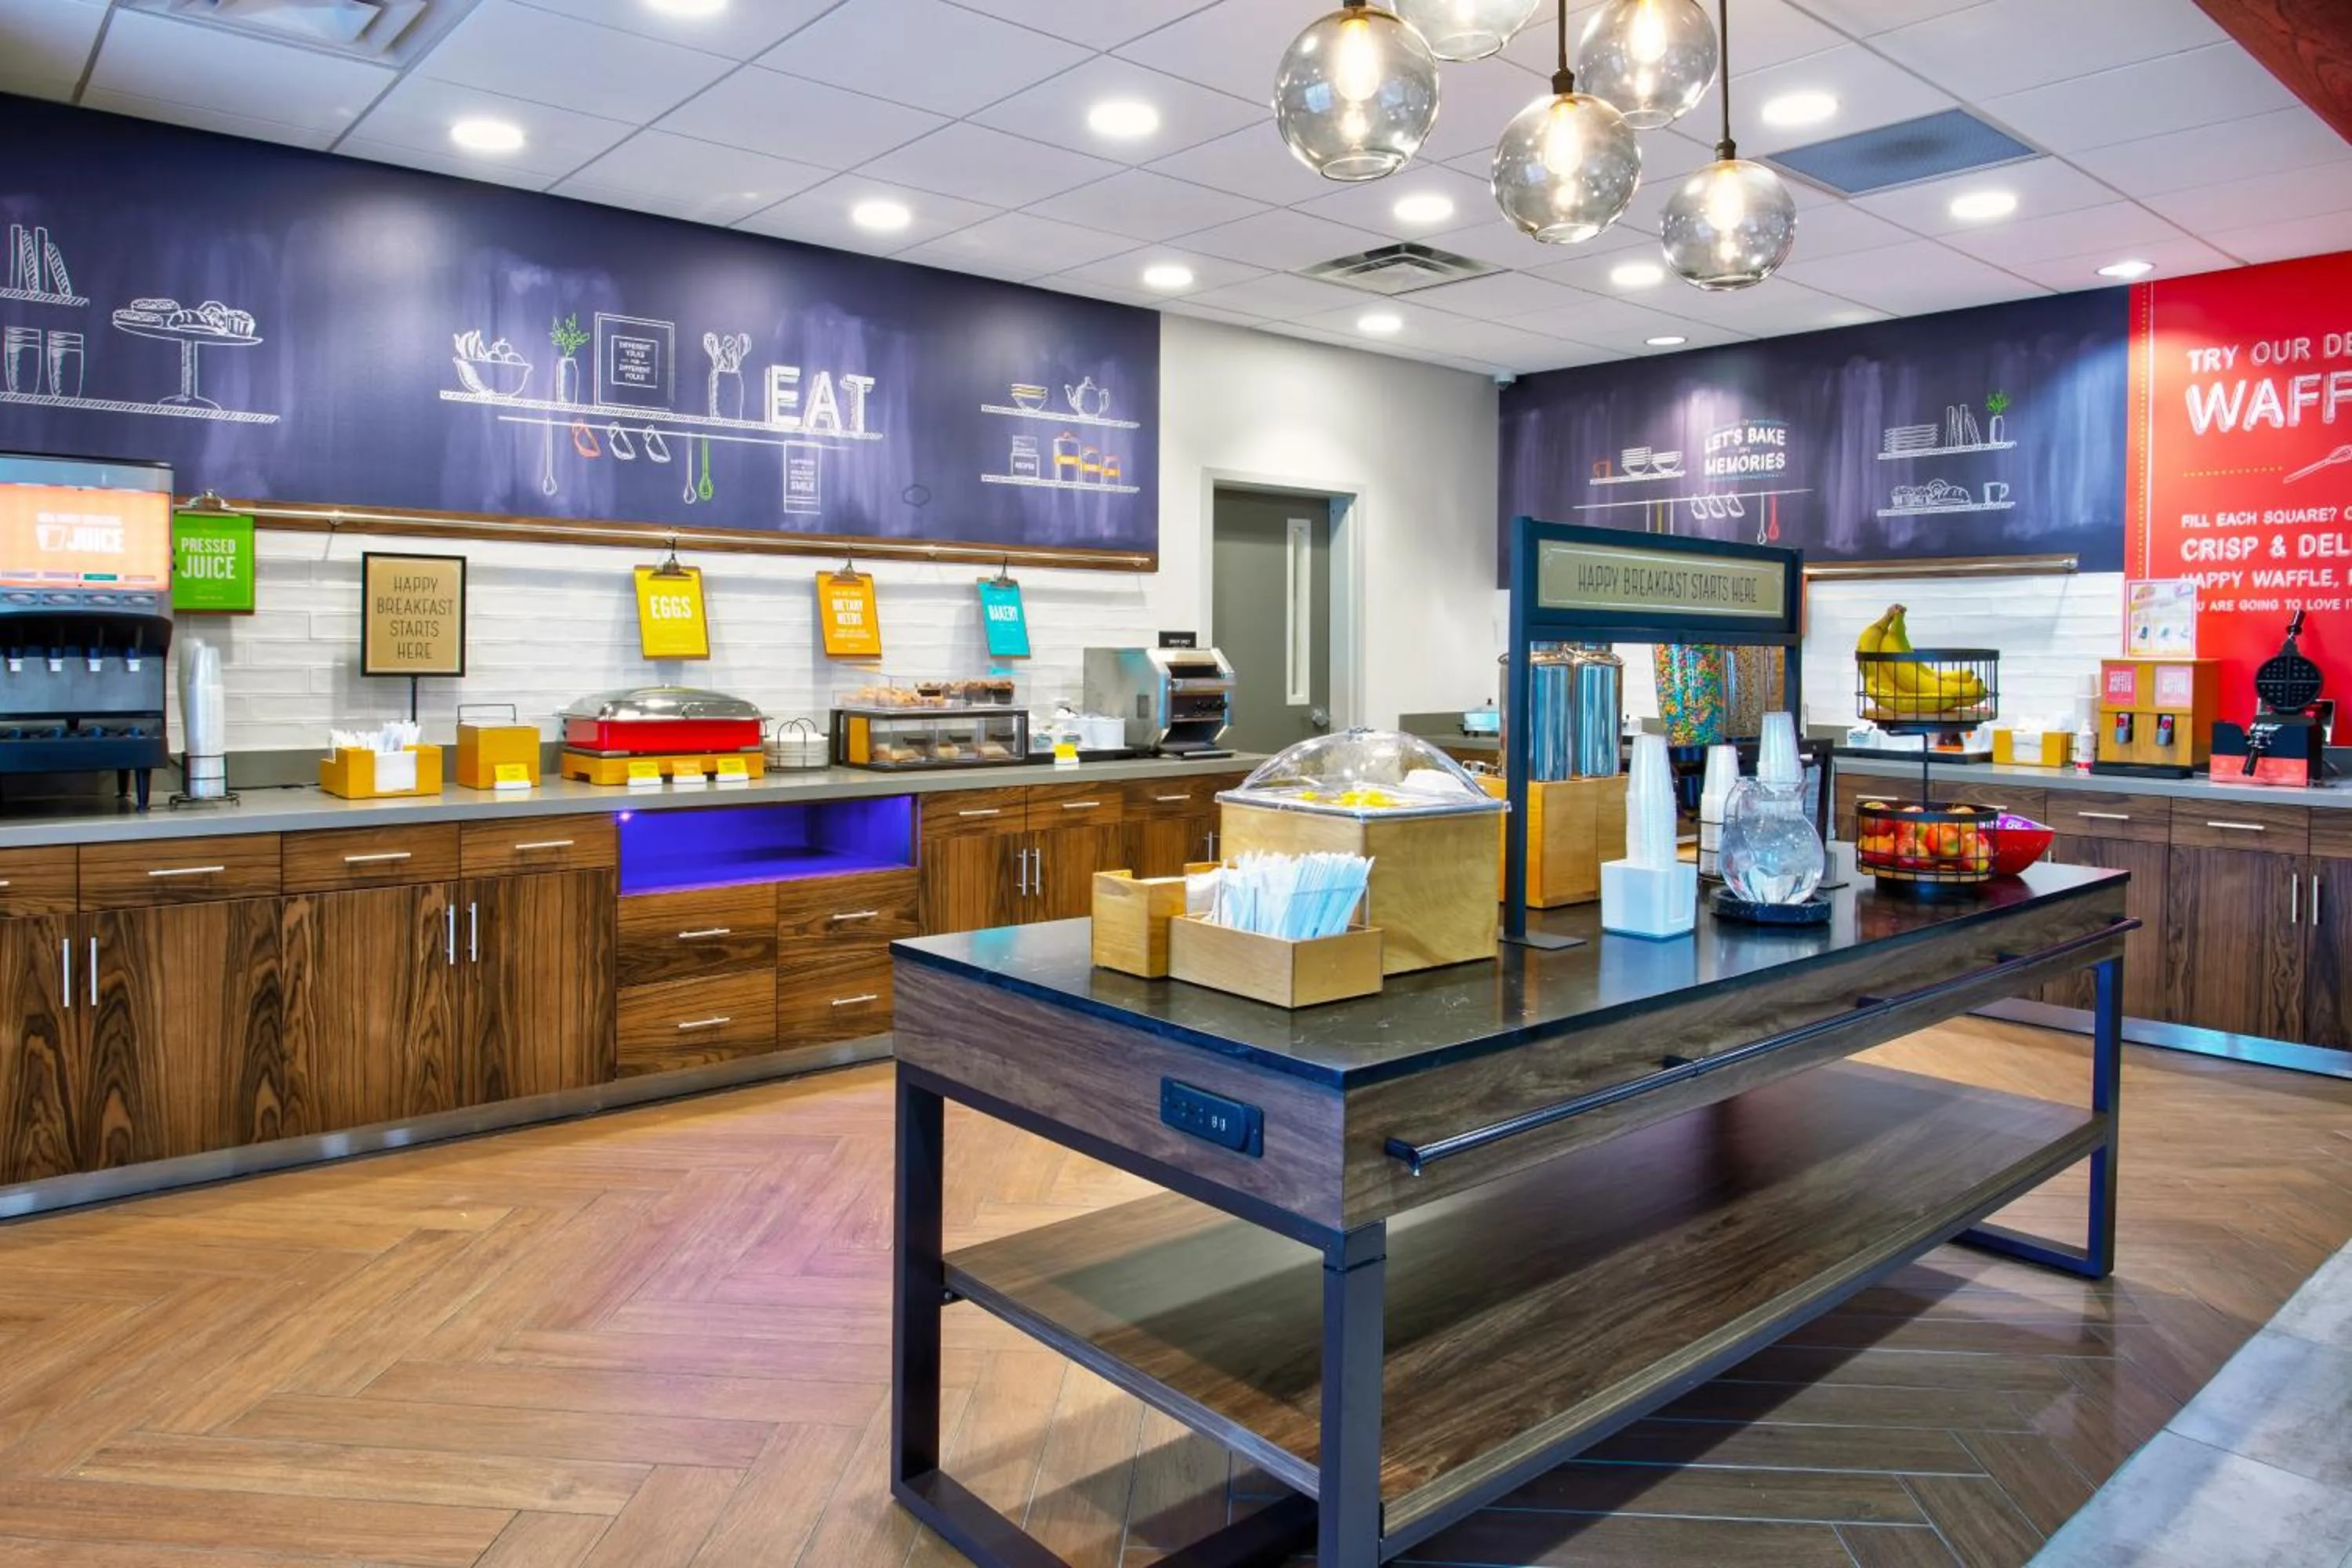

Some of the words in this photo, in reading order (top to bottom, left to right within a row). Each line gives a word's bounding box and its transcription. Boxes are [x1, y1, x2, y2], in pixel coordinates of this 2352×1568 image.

[2187, 345, 2238, 373] TRY
[2250, 337, 2311, 366] OUR
[765, 365, 876, 433] EAT
[1704, 429, 1742, 454] LET'S
[1748, 427, 1786, 446] BAKE
[1704, 452, 1785, 476] MEMORIES
[2181, 514, 2210, 528] FILL
[2216, 512, 2257, 526] EACH
[2263, 506, 2337, 524] SQUARE?
[65, 526, 125, 554] JUICE
[181, 537, 236, 554] PRESSED
[2181, 536, 2258, 562] CRISP
[2270, 534, 2287, 558] &
[181, 555, 236, 579] JUICE
[2252, 568, 2339, 589] WAFFLE,
[394, 576, 438, 593] HAPPY
[1578, 564, 1619, 593] HAPPY
[1624, 566, 1688, 598] BREAKFAST
[1691, 573, 1729, 602] STARTS
[1732, 576, 1757, 603] HERE
[377, 597, 453, 615] BREAKFAST
[650, 595, 693, 619] EGGS
[988, 604, 1019, 622] BAKERY
[2209, 599, 2234, 612] ARE
[2239, 598, 2279, 612] GOING
[2285, 598, 2303, 611] TO
[2307, 598, 2341, 612] LOVE
[390, 619, 440, 637] STARTS
[397, 642, 434, 659] HERE
